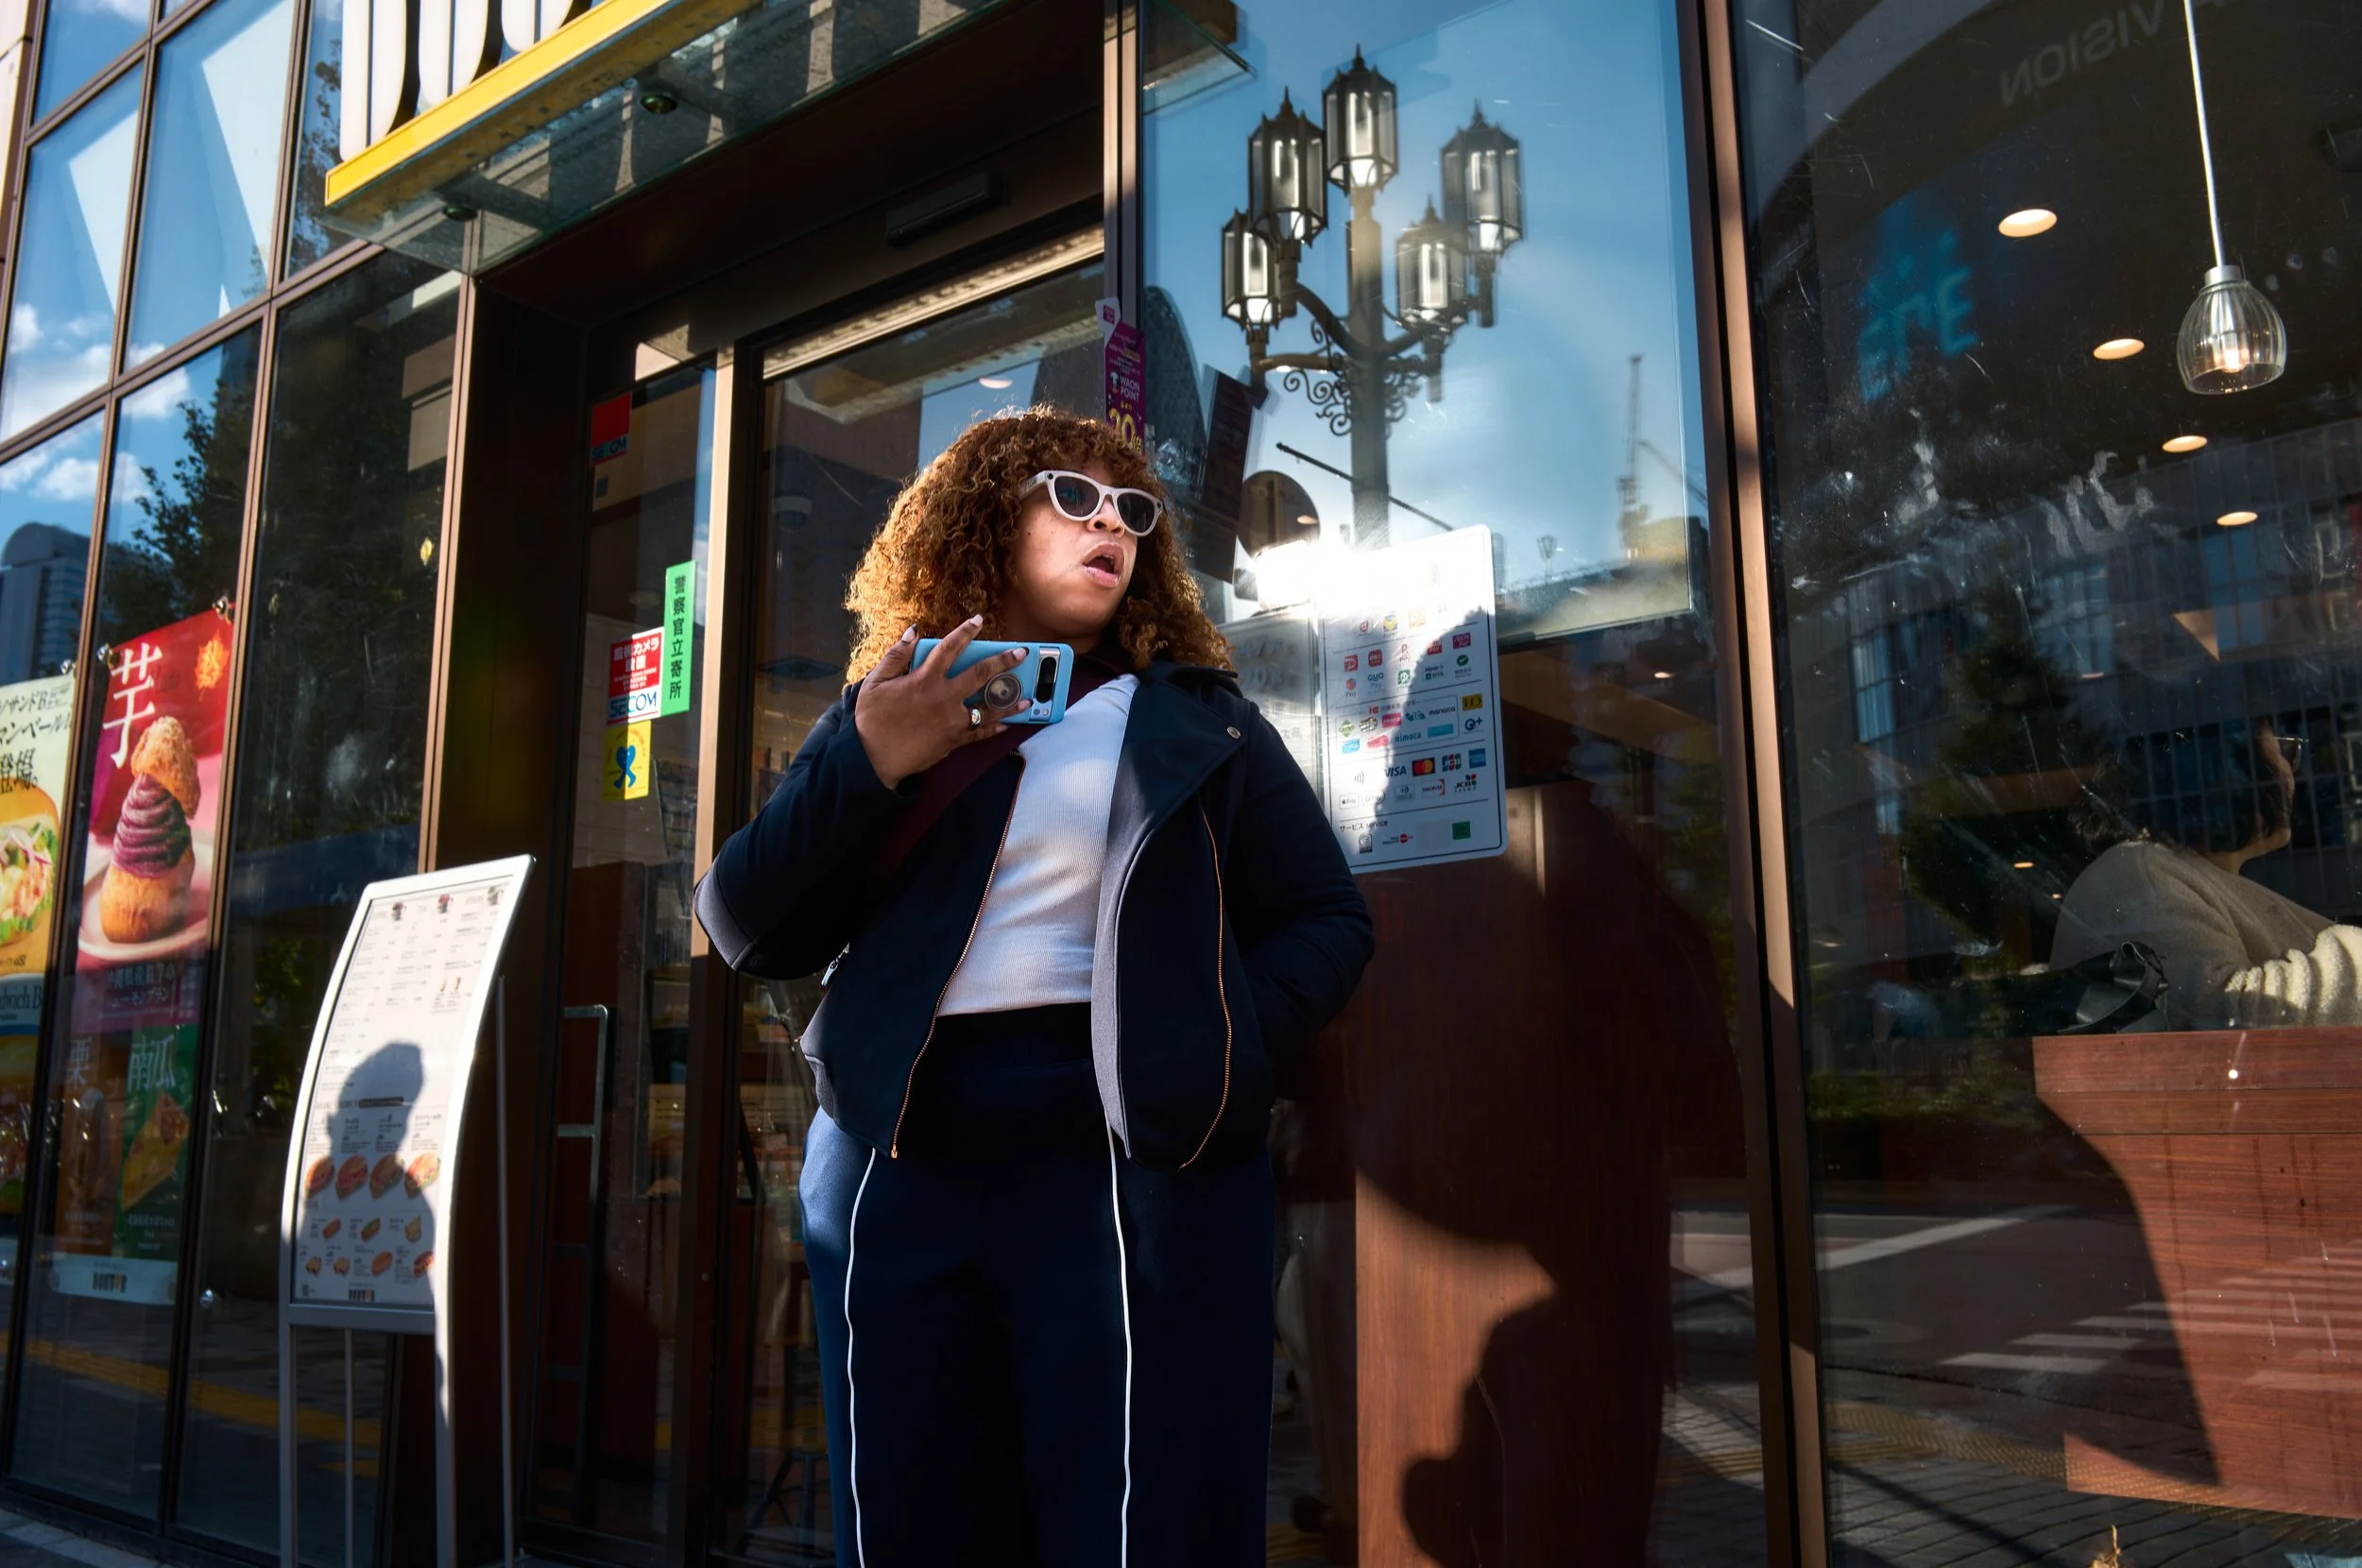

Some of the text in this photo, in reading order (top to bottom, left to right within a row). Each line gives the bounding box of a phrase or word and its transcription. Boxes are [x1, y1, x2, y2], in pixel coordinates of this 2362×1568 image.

[1120, 374, 1140, 391] WAON
[1121, 385, 1140, 403] POINT
[668, 573, 688, 701] 警察官立寄所
[609, 690, 658, 718] SECOM
[1395, 732, 1421, 743] nimoca
[1384, 766, 1407, 777] VISA
[1340, 819, 1389, 832] サービス service
